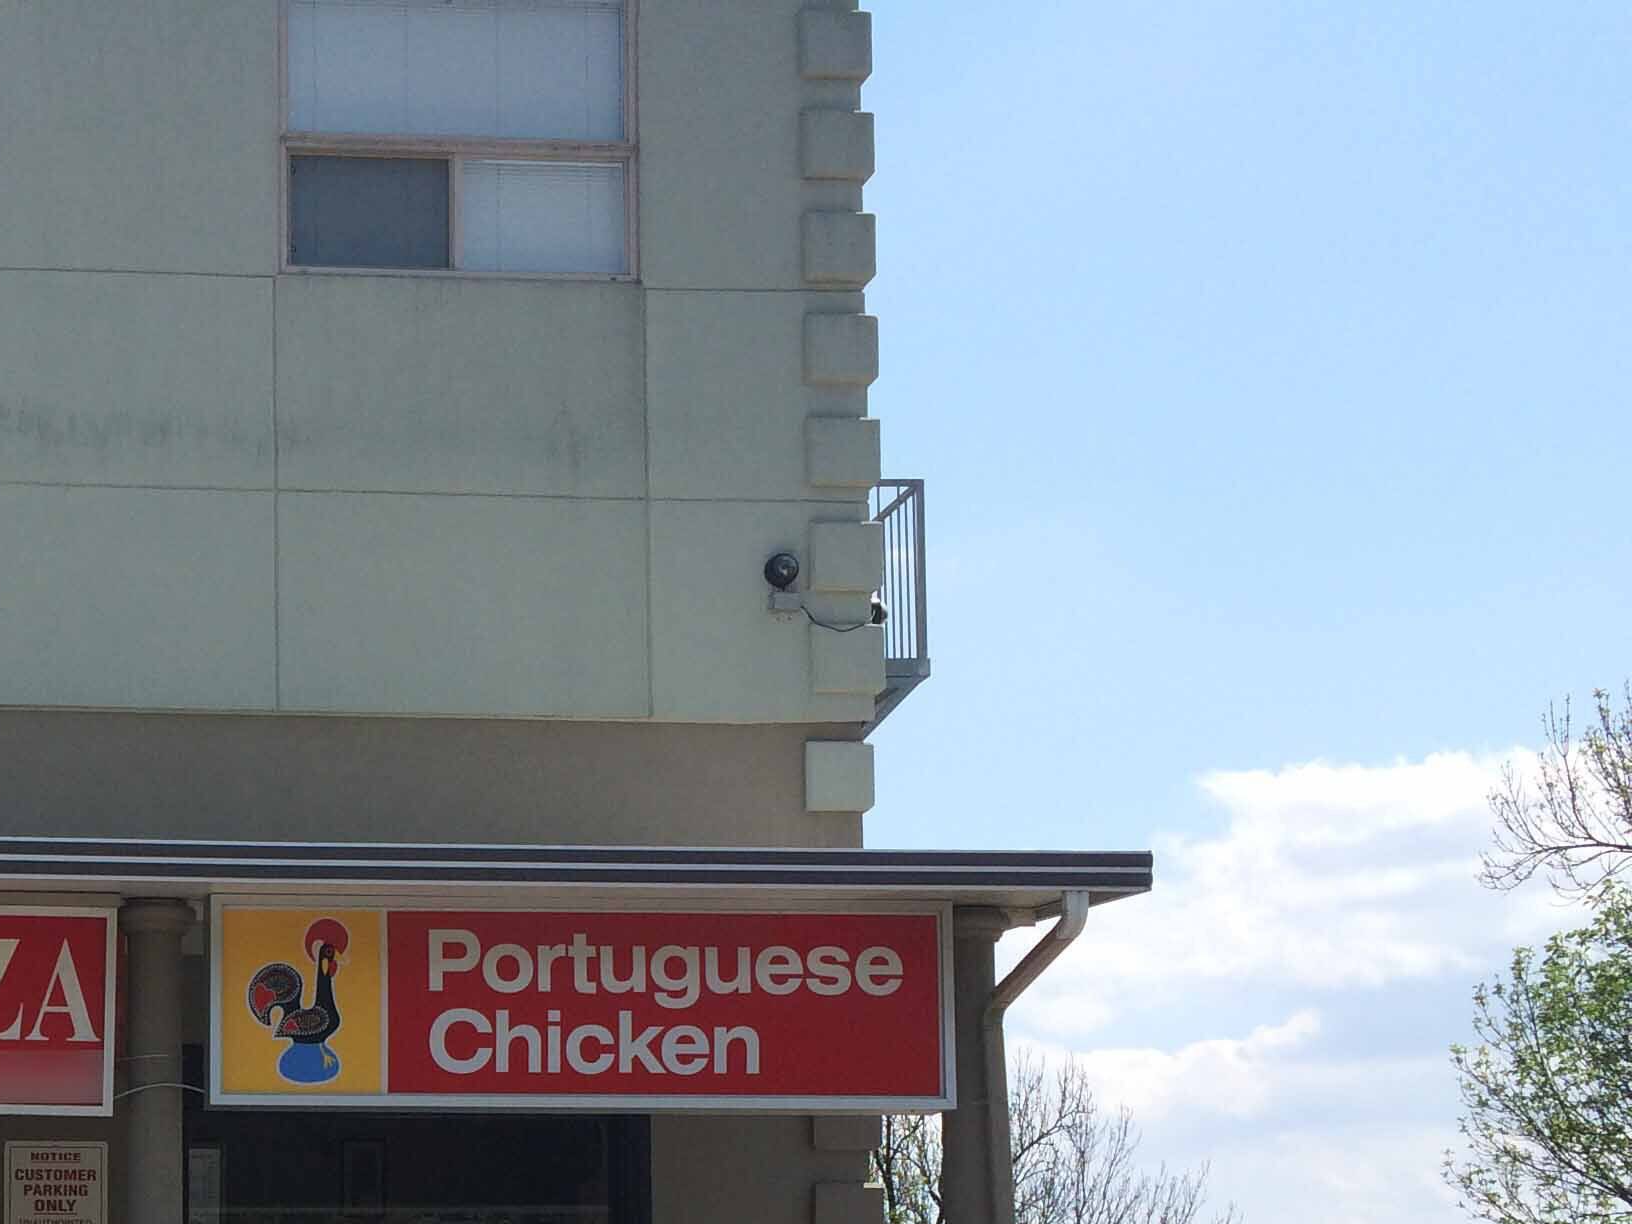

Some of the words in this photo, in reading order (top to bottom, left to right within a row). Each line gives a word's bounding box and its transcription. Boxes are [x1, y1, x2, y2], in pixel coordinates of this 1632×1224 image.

[427, 928, 904, 1009] Portuguese
[429, 1007, 761, 1076] Chicken
[30, 1152, 81, 1161] NOTICE
[14, 1168, 97, 1181] CUSTOMER
[23, 1184, 88, 1197] PARKING
[34, 1200, 77, 1212] ONLY
